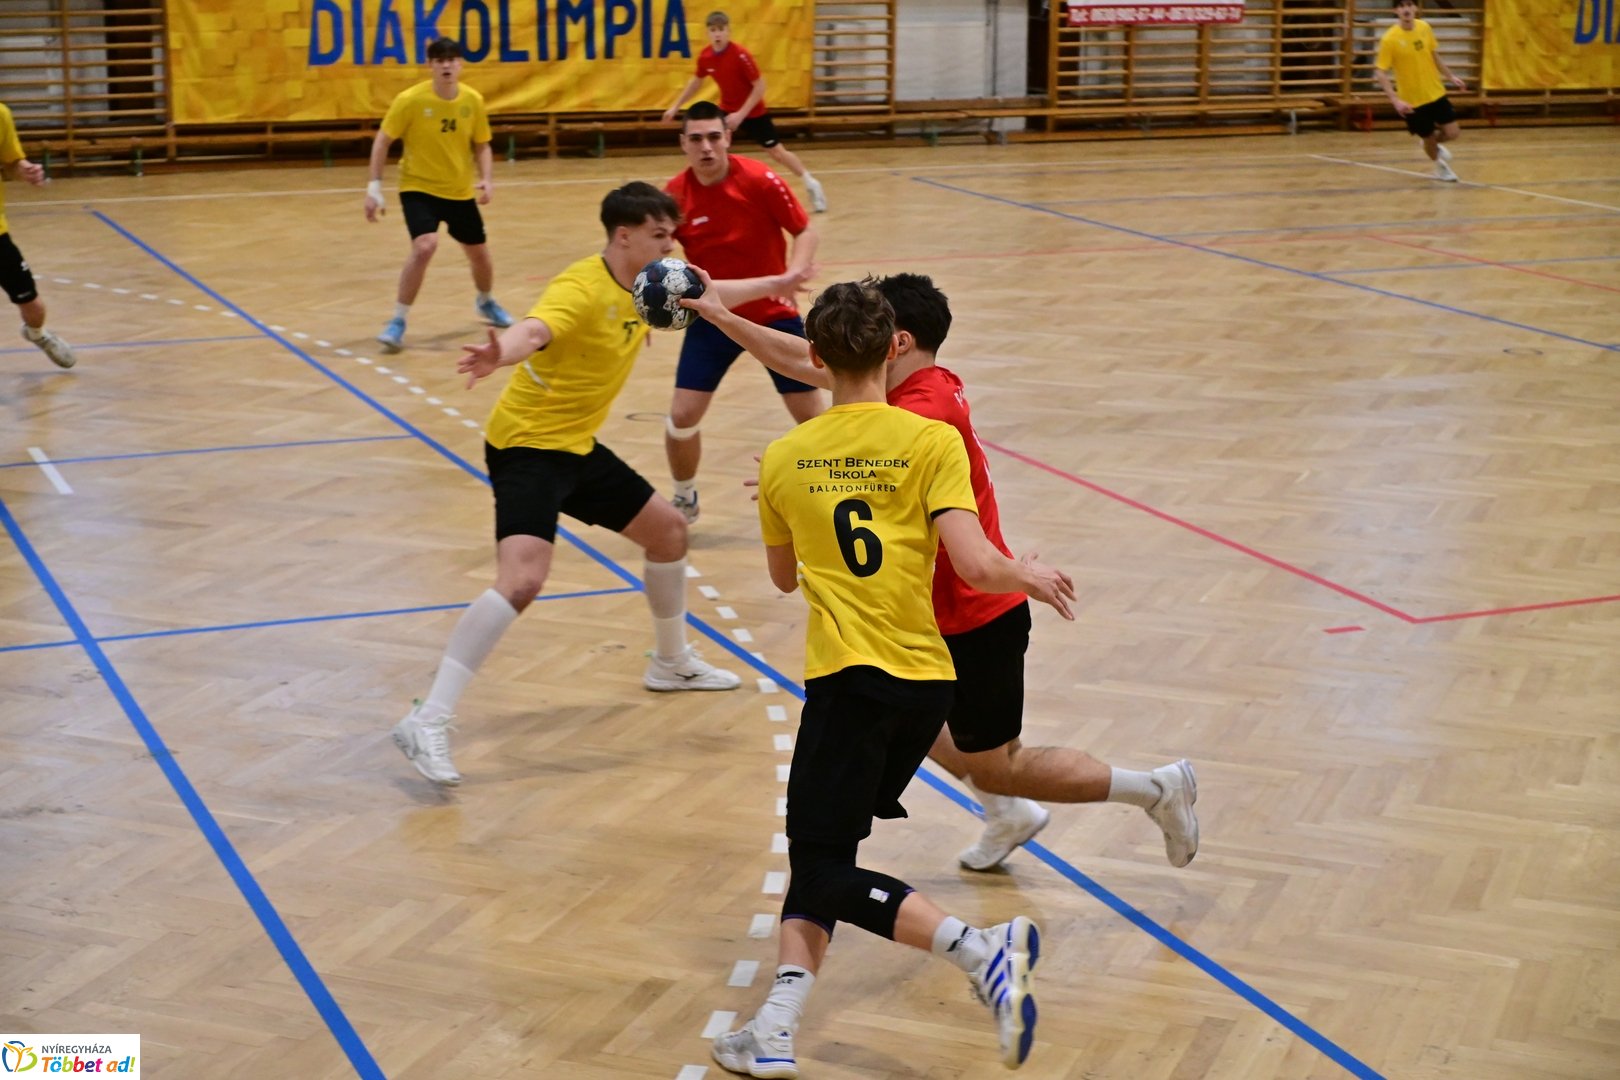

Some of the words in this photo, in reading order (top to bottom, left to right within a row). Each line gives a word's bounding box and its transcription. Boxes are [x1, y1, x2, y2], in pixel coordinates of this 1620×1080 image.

[1573, 0, 1620, 45] DI
[440, 118, 457, 133] 24
[797, 459, 841, 469] SZENT
[845, 457, 909, 468] BENEDEK
[829, 469, 876, 479] ISKOLA
[809, 483, 896, 493] BALATONFÜRED
[833, 498, 883, 578] 6
